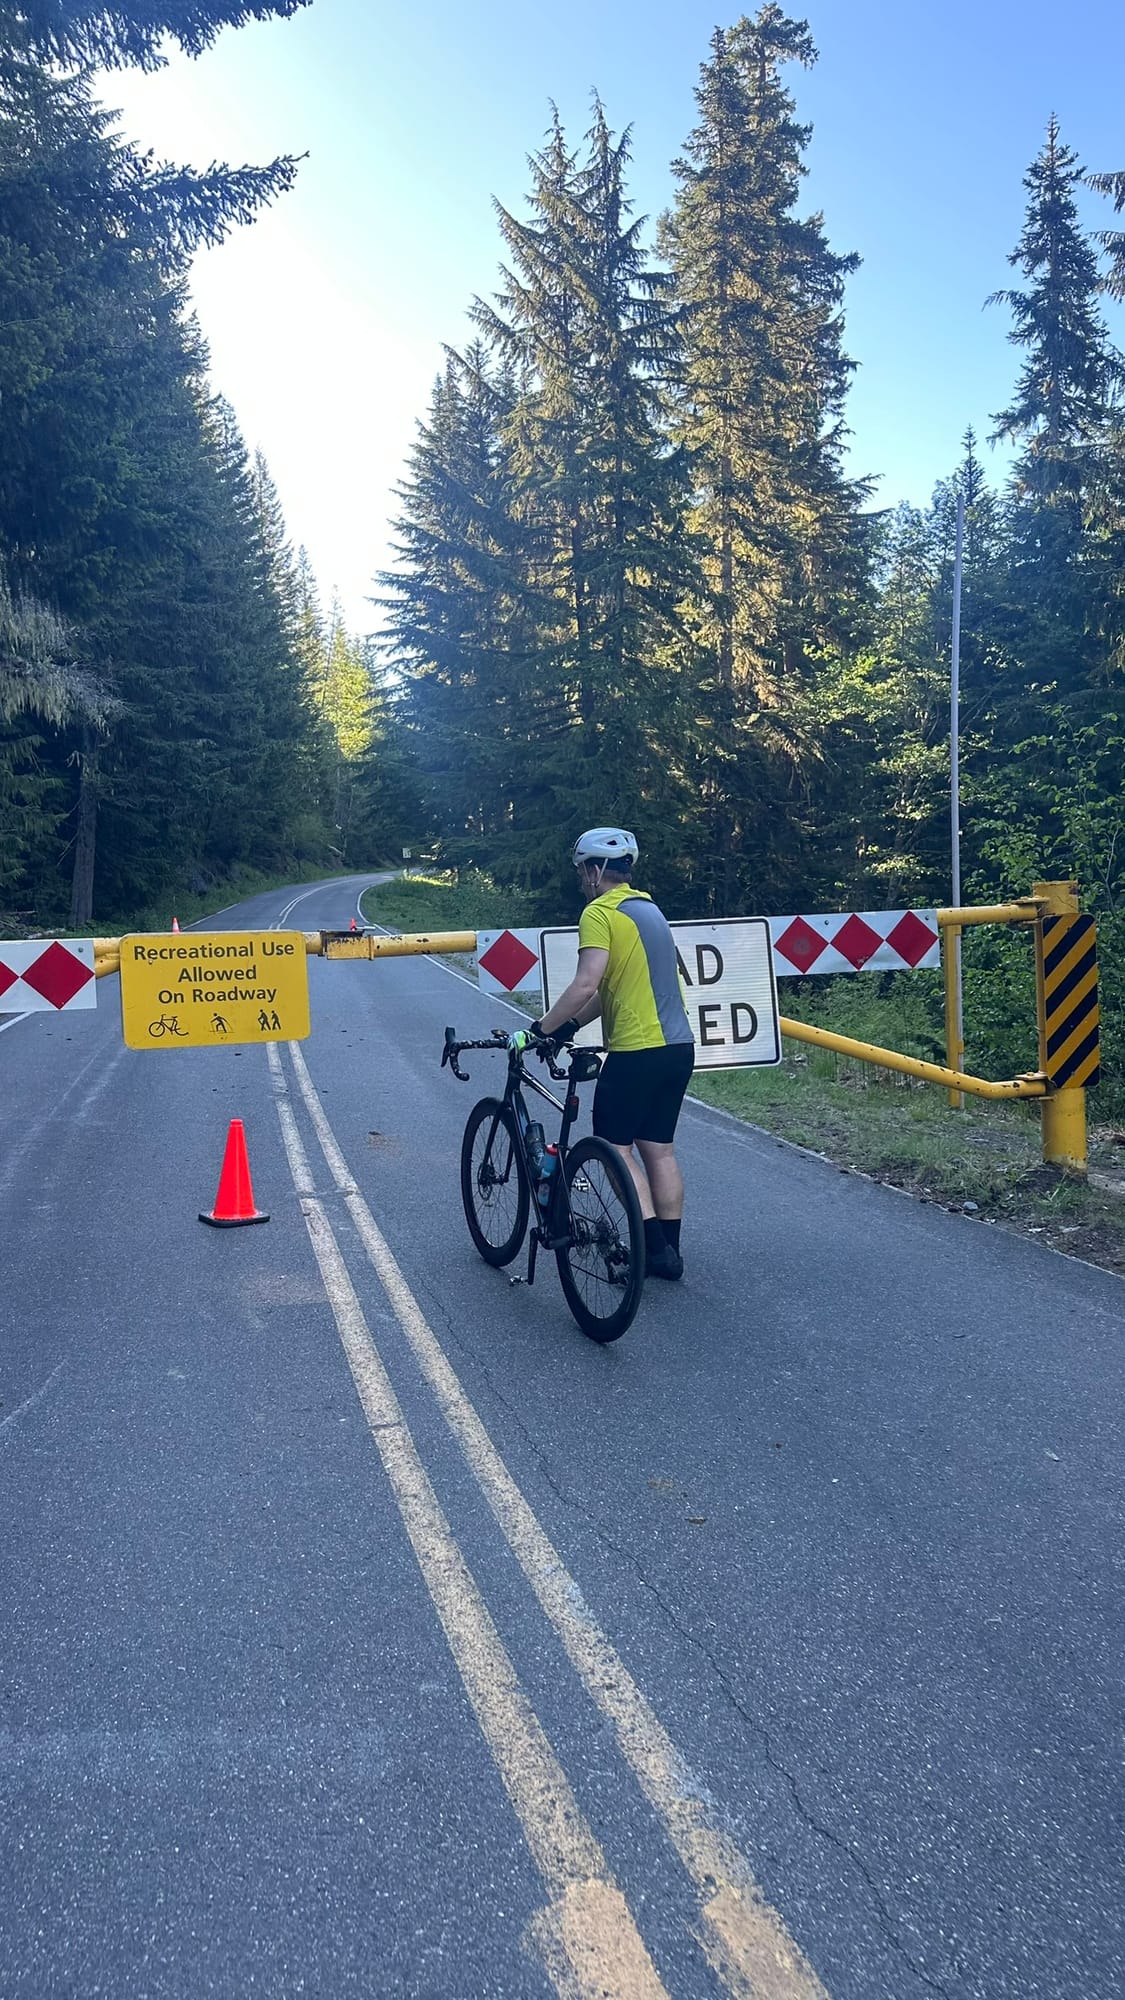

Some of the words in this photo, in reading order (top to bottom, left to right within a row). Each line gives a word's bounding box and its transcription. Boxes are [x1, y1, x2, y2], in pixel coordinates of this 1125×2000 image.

[134, 941, 254, 961] Recreational
[262, 942, 294, 956] Use
[178, 965, 257, 983] Allowed
[158, 990, 185, 1004] On
[192, 986, 277, 1003] Roadway
